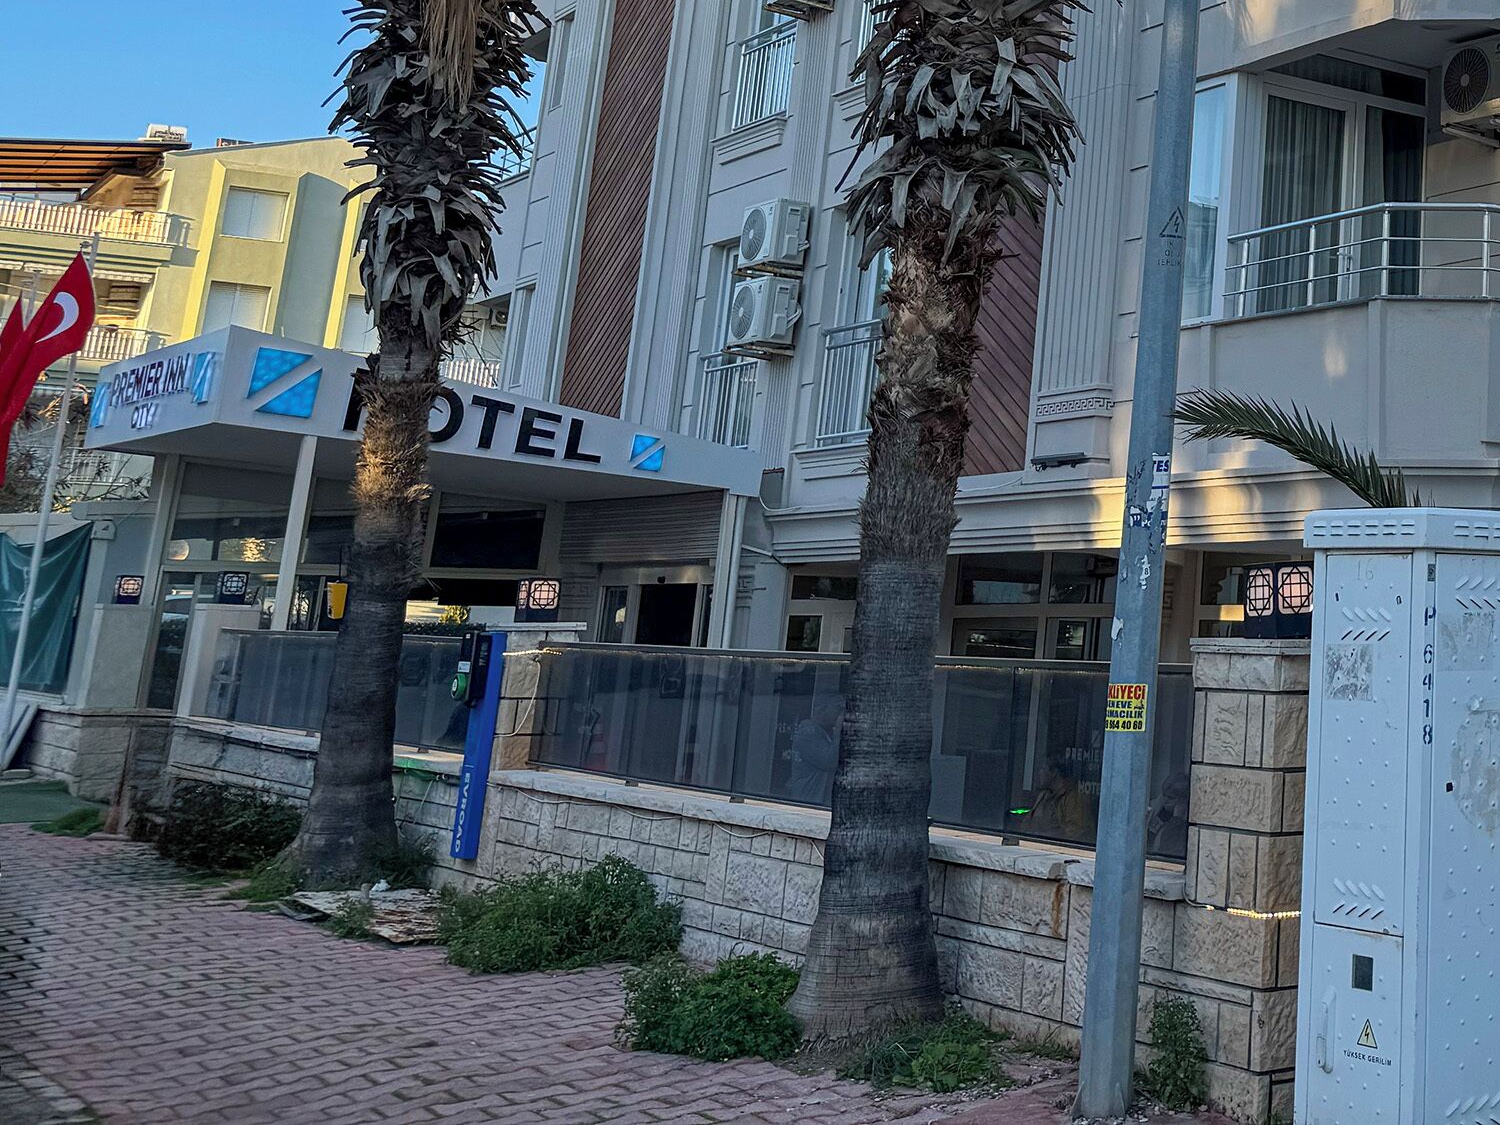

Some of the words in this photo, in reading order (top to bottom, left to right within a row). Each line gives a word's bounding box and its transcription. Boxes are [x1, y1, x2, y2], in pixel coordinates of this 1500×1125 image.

[110, 360, 164, 409] PREMIER
[162, 352, 191, 393] INN
[1121, 720, 1132, 730] 40
[1132, 720, 1143, 730] 60
[454, 773, 471, 853] EVROAD
[1343, 1049, 1366, 1061] YÜKSEK
